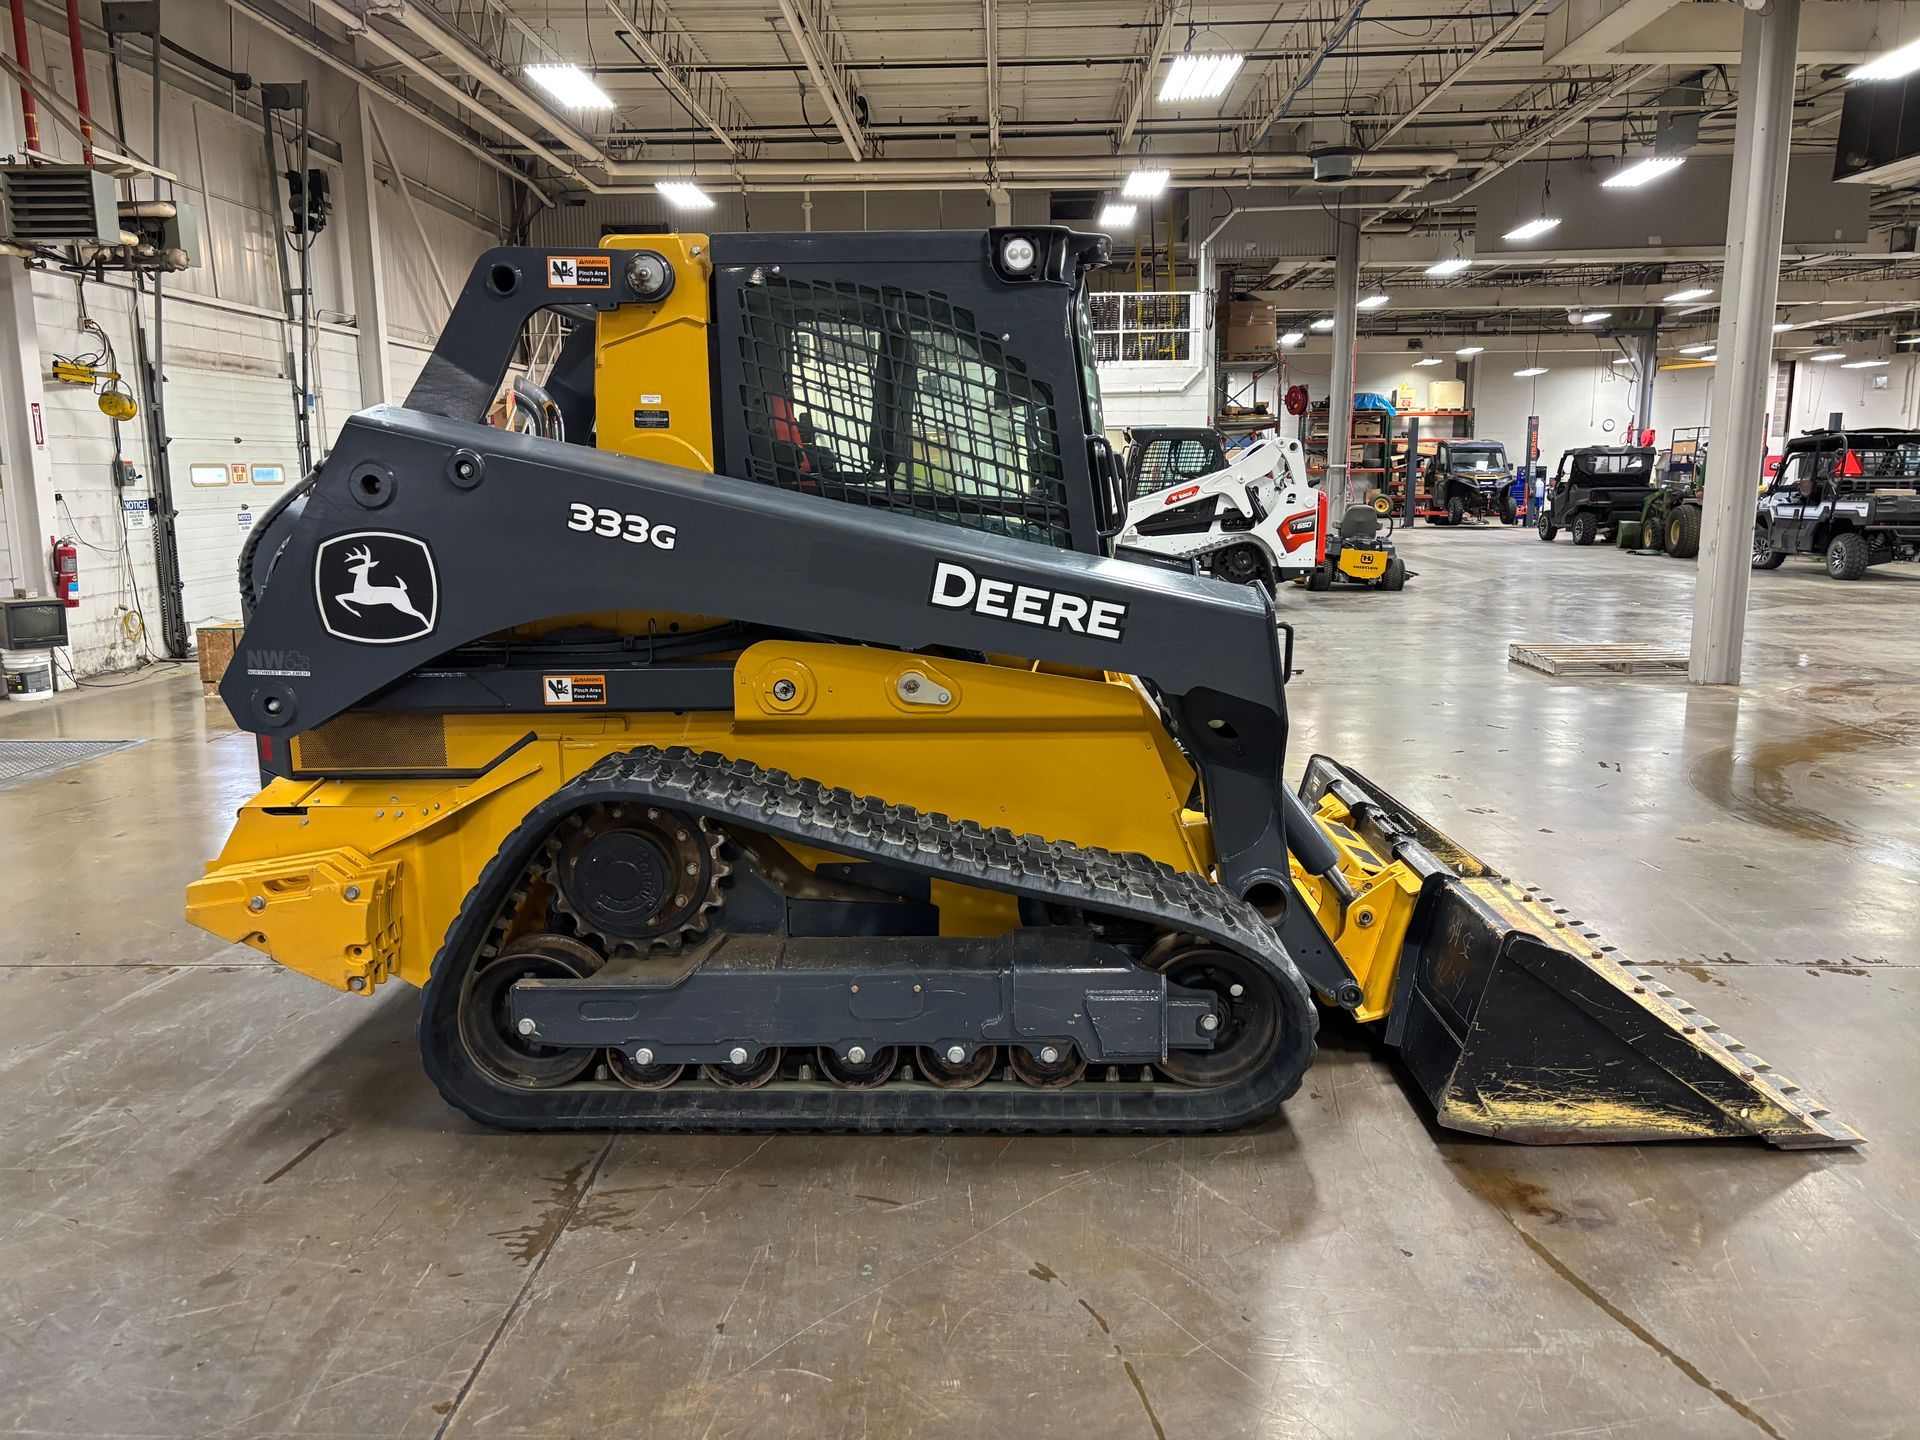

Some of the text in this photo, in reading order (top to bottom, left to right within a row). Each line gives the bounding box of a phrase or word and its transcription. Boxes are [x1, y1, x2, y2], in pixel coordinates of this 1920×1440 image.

[124, 501, 147, 510] NOTICE
[567, 503, 677, 549] 333G
[931, 562, 1126, 639] DEERE
[247, 650, 284, 669] NW
